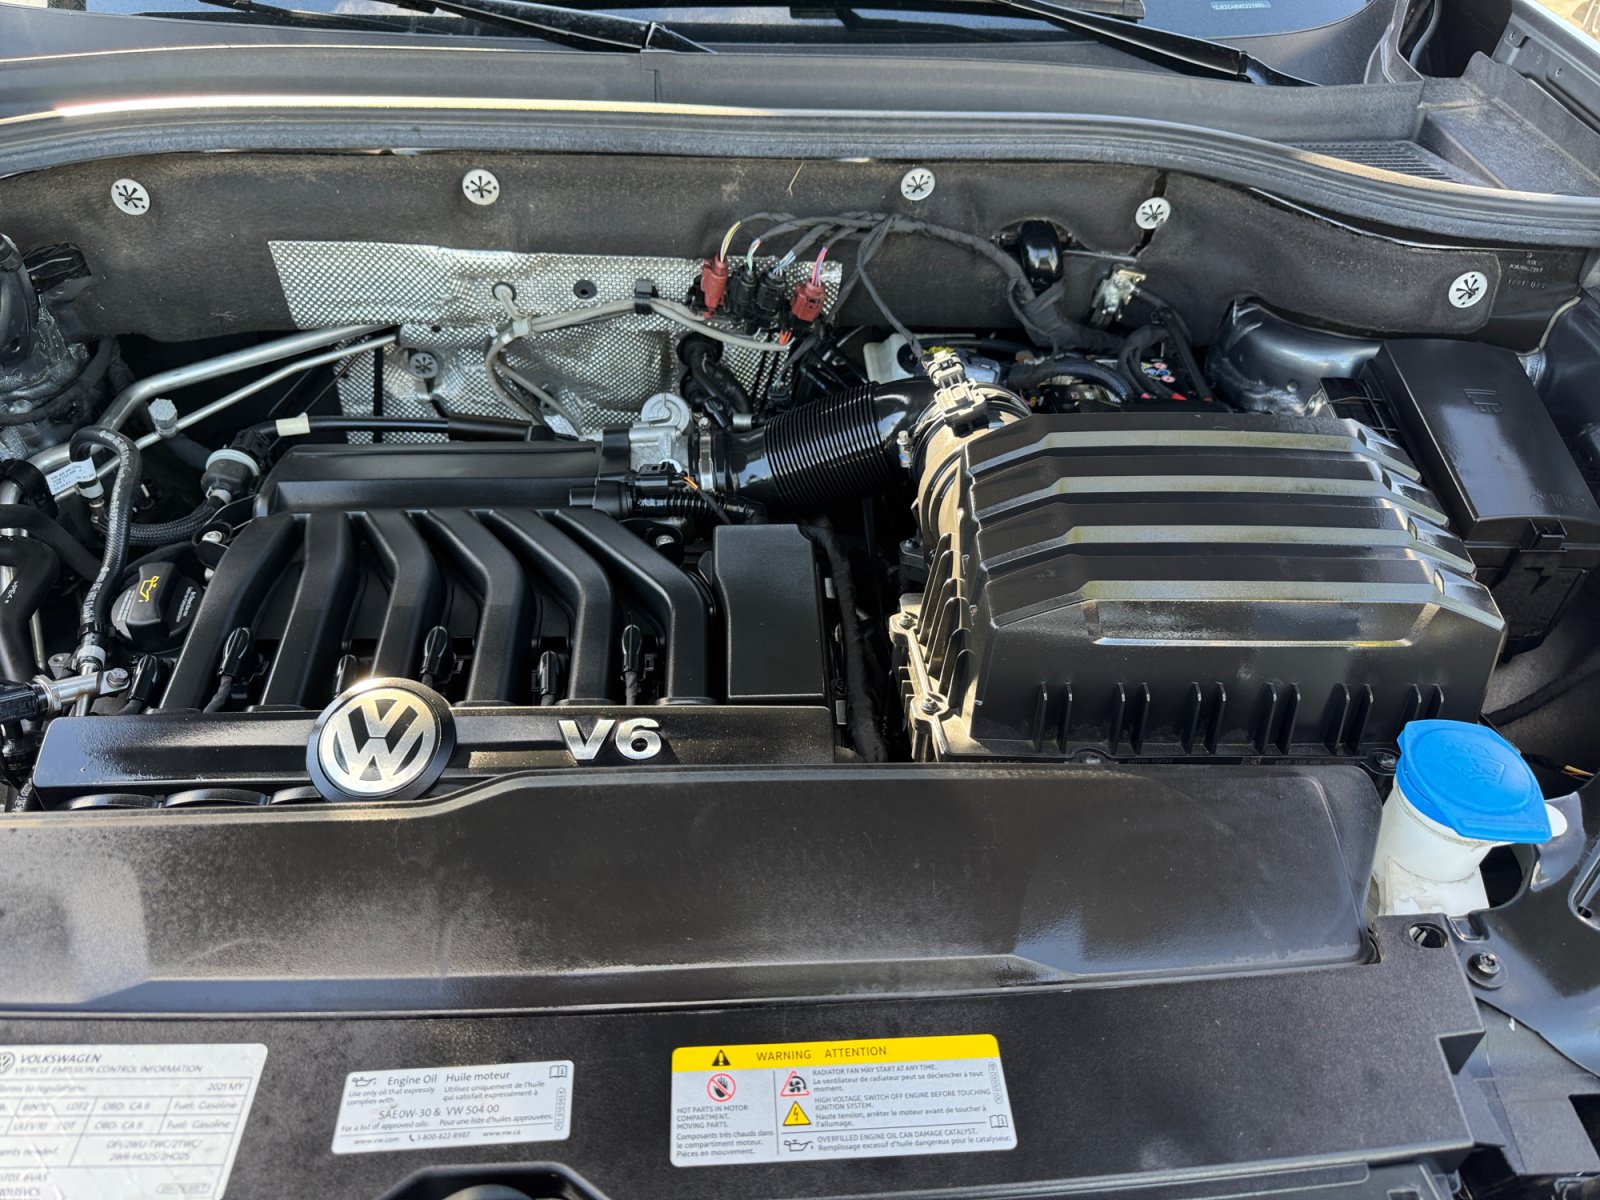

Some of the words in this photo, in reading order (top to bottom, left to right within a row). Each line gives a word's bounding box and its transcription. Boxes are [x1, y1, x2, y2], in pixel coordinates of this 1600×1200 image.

[319, 686, 437, 797] VW
[557, 718, 662, 761] V6
[756, 1050, 812, 1061] WARNING
[824, 1046, 887, 1058] ATTENTION
[20, 1054, 102, 1064] VOLKSWAGEN
[16, 1066, 49, 1074] VEHICLE
[96, 1065, 137, 1073] CONTROL
[140, 1065, 203, 1073] INFORMATION
[812, 1068, 845, 1076] RADIATOR
[388, 1076, 421, 1087] Engine
[423, 1074, 438, 1084] Oil
[446, 1072, 472, 1082] Huile
[474, 1071, 510, 1080] moteur
[208, 1083, 228, 1091] 2021
[362, 1089, 377, 1097] only
[379, 1088, 387, 1096] oil
[404, 1087, 435, 1095] expressly
[444, 1085, 470, 1093] Utilisez
[471, 1083, 512, 1093] uniquement
[957, 1088, 991, 1096] TOUCHING
[442, 1093, 455, 1101] qui
[456, 1091, 483, 1100] satisfait
[484, 1089, 532, 1100] expressément
[198, 1101, 238, 1110] Gasoline
[346, 1098, 377, 1106] complies
[378, 1096, 394, 1104] with
[433, 1108, 441, 1116] &
[446, 1106, 464, 1115] VW
[466, 1105, 484, 1114] 504
[486, 1104, 500, 1114] 00
[676, 1106, 691, 1114] HOT
[816, 1103, 845, 1111] IGNITION
[846, 1102, 874, 1110] SYSTEM.
[676, 1113, 730, 1122] COMPARTMENT.
[192, 1120, 230, 1129] Gasoline
[372, 1122, 380, 1130] of
[380, 1121, 414, 1130] approved
[354, 1136, 400, 1144] www.vw.com
[676, 1132, 718, 1140] Composants
[733, 1130, 756, 1138] chauds
[817, 1134, 858, 1142] OVERFILLED
[944, 1128, 978, 1136] CATALYST.
[684, 1140, 735, 1149] compartiment
[818, 1144, 860, 1152] Remplissage
[890, 1140, 913, 1148] d'huile
[915, 1139, 950, 1147] dangereux
[975, 1136, 1012, 1144] catalyseur.
[710, 1148, 756, 1156] mouvement.
